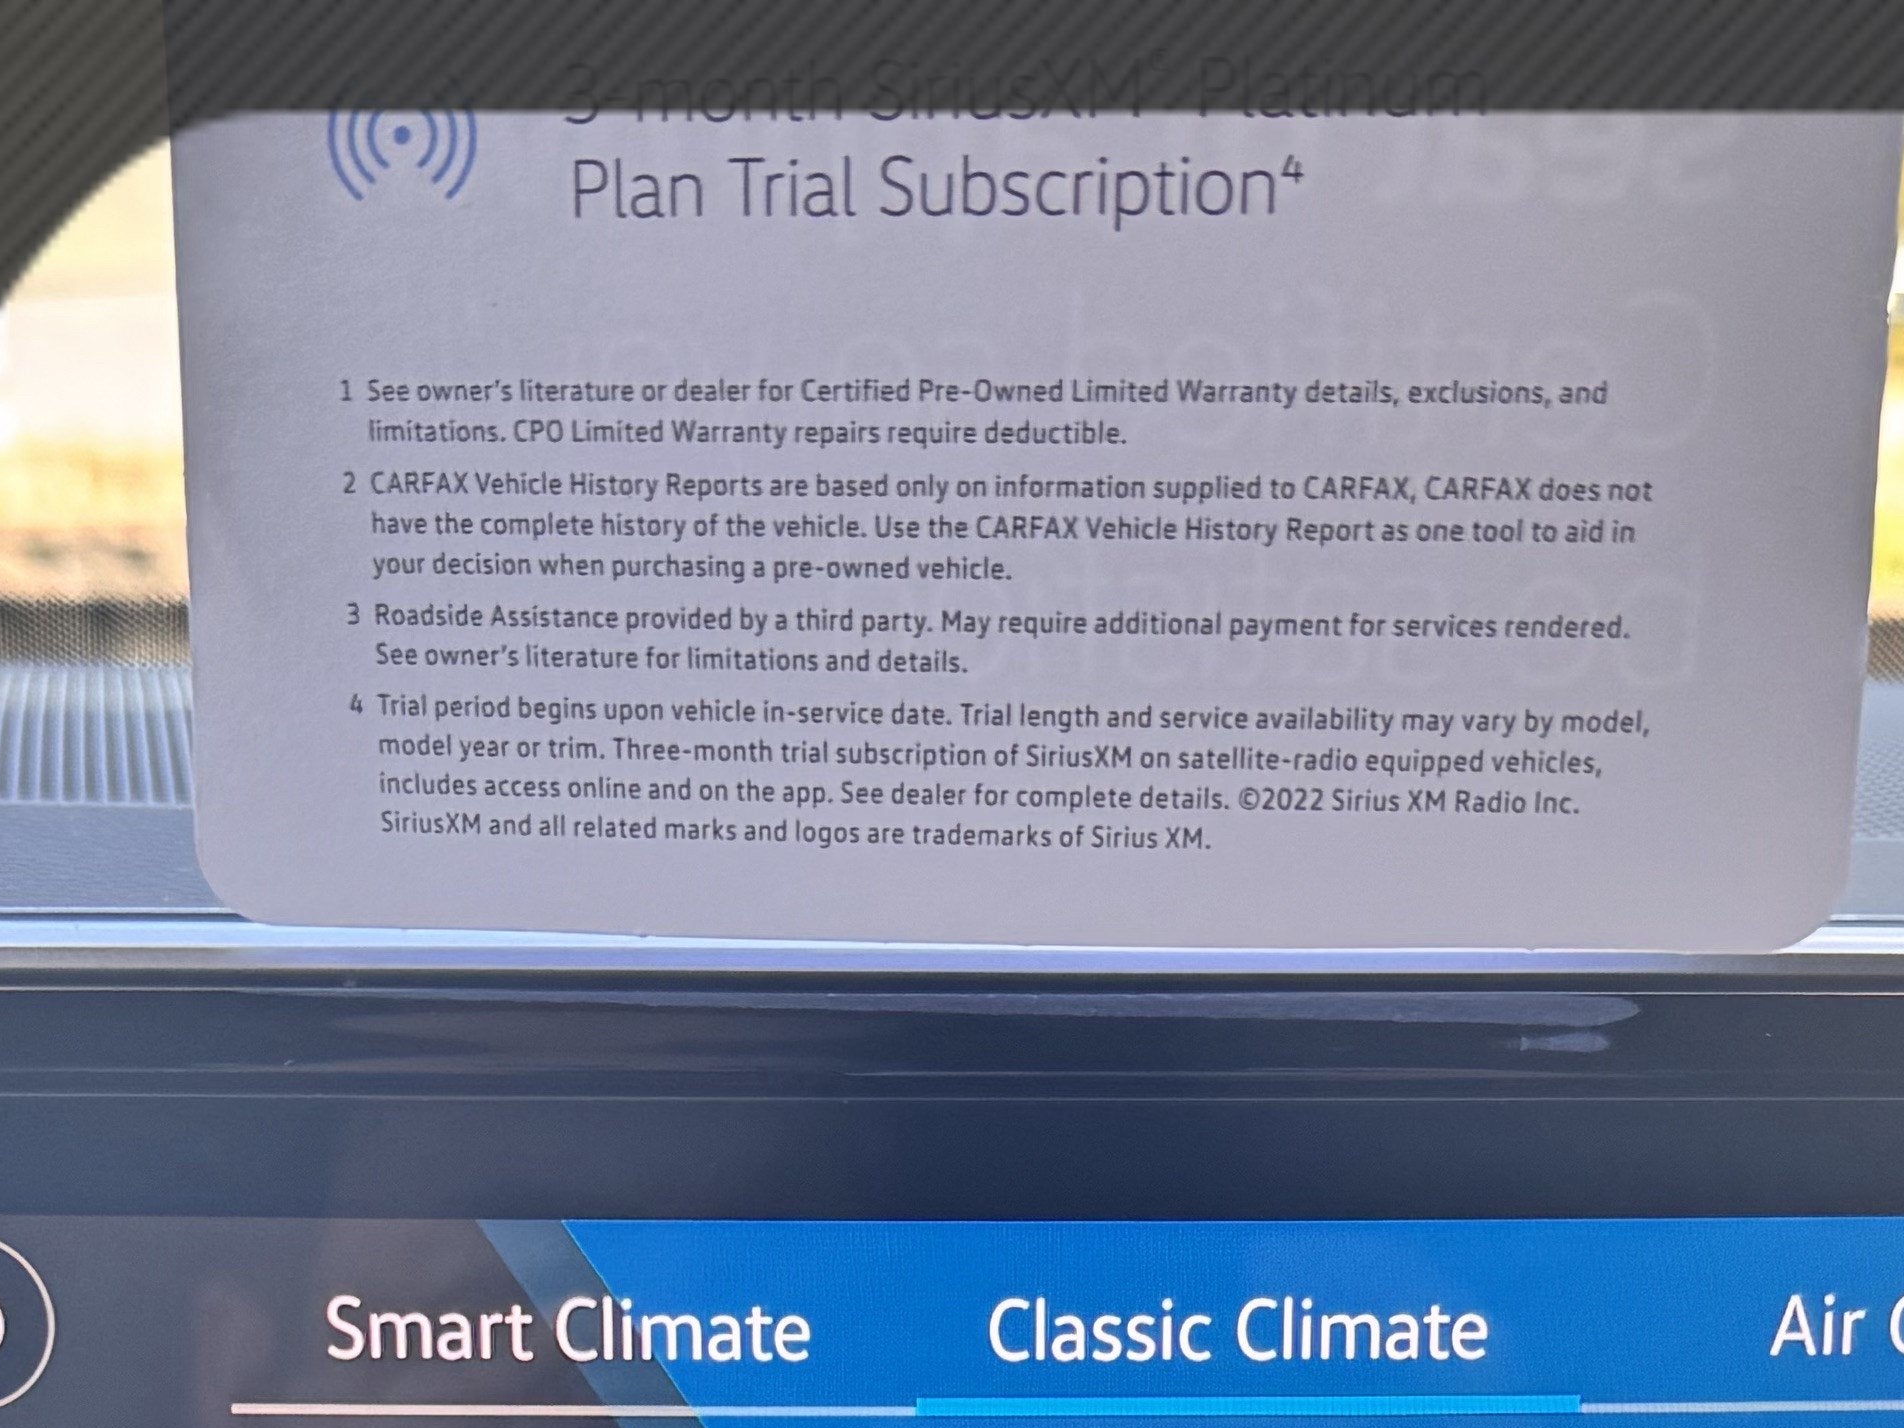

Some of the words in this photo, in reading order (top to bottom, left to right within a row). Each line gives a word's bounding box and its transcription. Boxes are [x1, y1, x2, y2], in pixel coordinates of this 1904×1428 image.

[574, 158, 703, 219] Plan
[728, 156, 856, 217] Trial
[340, 378, 353, 403] 1
[367, 378, 410, 403] See
[519, 378, 635, 403] literature
[640, 383, 668, 403] or
[673, 377, 752, 403] dealer
[757, 377, 795, 403] for
[800, 377, 911, 403] Certified
[918, 377, 1064, 404] Pre-Owned
[1071, 378, 1170, 404] Limited
[1176, 378, 1298, 410] Warranty
[1304, 379, 1400, 408] details,
[1407, 379, 1552, 409] exclusions,
[1558, 380, 1609, 405] and
[368, 418, 507, 444] limitations.
[513, 418, 564, 444] CPO
[571, 419, 664, 444] Limited
[670, 419, 788, 451] Warranty
[793, 419, 881, 450] repairs
[887, 420, 978, 450] require
[984, 419, 1128, 445] deductible.
[342, 470, 357, 495] 2
[369, 470, 469, 496] CARFAX
[473, 470, 563, 496] Vehicle
[569, 472, 659, 503] History
[665, 471, 764, 502] Reports
[769, 478, 809, 498] are
[815, 472, 889, 498] based
[895, 473, 950, 505] only
[955, 479, 988, 499] on
[994, 473, 1146, 500] information
[1152, 474, 1262, 506] supplied
[1269, 478, 1297, 500] to
[1303, 474, 1417, 505] CARFAX,
[1424, 474, 1533, 501] CARFAX
[1538, 476, 1602, 502] does
[1607, 481, 1653, 503] not
[372, 556, 426, 581] your
[431, 551, 533, 577] decision
[537, 552, 605, 577] when
[611, 552, 746, 585] purchasing
[752, 559, 766, 579] a
[772, 555, 911, 585] pre-owned
[916, 555, 1013, 581] vehicle.
[346, 601, 361, 626] 3
[374, 602, 484, 628] Roadside
[490, 603, 620, 630] Assistance
[625, 606, 733, 635] provided
[739, 606, 769, 638] by
[774, 612, 789, 632] a
[795, 606, 854, 633] third
[860, 612, 934, 639] party.
[941, 609, 992, 641] May
[997, 610, 1088, 640] require
[1093, 610, 1222, 636] additional
[1228, 615, 1343, 643] payment
[1349, 611, 1387, 638] for
[1392, 613, 1498, 639] services
[1504, 614, 1631, 640] rendered.
[375, 641, 419, 666] See
[525, 643, 639, 670] literature
[645, 645, 681, 670] for
[686, 645, 820, 673] limitations
[825, 648, 871, 673] and
[876, 648, 969, 674] details.
[348, 692, 364, 715] 4
[376, 692, 428, 718] Trial
[434, 694, 511, 722] period
[517, 695, 598, 726] begins
[603, 702, 665, 726] upon
[670, 698, 757, 724] vehicle
[762, 699, 885, 726] in-service
[890, 700, 953, 727] date.
[959, 701, 1013, 727] Trial
[1019, 702, 1100, 734] length
[1106, 704, 1153, 729] and
[1159, 705, 1249, 731] service
[1254, 705, 1395, 738] availability
[1401, 713, 1455, 738] may
[1461, 713, 1517, 739] vary
[1523, 708, 1554, 740] by
[1561, 709, 1650, 738] model,
[379, 771, 478, 797] includes
[483, 778, 561, 799] access
[567, 775, 642, 801] online
[647, 776, 692, 802] and
[698, 783, 729, 802] on
[735, 778, 776, 804] the
[782, 784, 834, 809] app.
[840, 779, 885, 806] See
[890, 781, 967, 807] dealer
[973, 782, 1010, 808] for
[1015, 784, 1133, 814] complete
[1138, 784, 1231, 811] details.
[1331, 787, 1401, 813] Sirius
[1407, 788, 1447, 813] XM
[1454, 788, 1528, 815] Radio
[1534, 790, 1580, 815] Inc.
[380, 809, 482, 835] SiriusXM
[488, 813, 532, 837] and
[538, 813, 566, 837] all
[573, 814, 657, 840] related
[664, 817, 738, 842] marks
[743, 818, 788, 843] and
[795, 818, 861, 850] logos
[866, 826, 906, 845] are
[912, 822, 1053, 848] trademarks
[1058, 823, 1085, 849] of
[1090, 824, 1159, 850] Sirius
[1164, 826, 1212, 850] XM.
[327, 1295, 533, 1361] Smart
[556, 1296, 810, 1361] Climate
[990, 1298, 1211, 1361] Classic
[1237, 1296, 1487, 1361] Climate
[1770, 1294, 1865, 1355] Air
